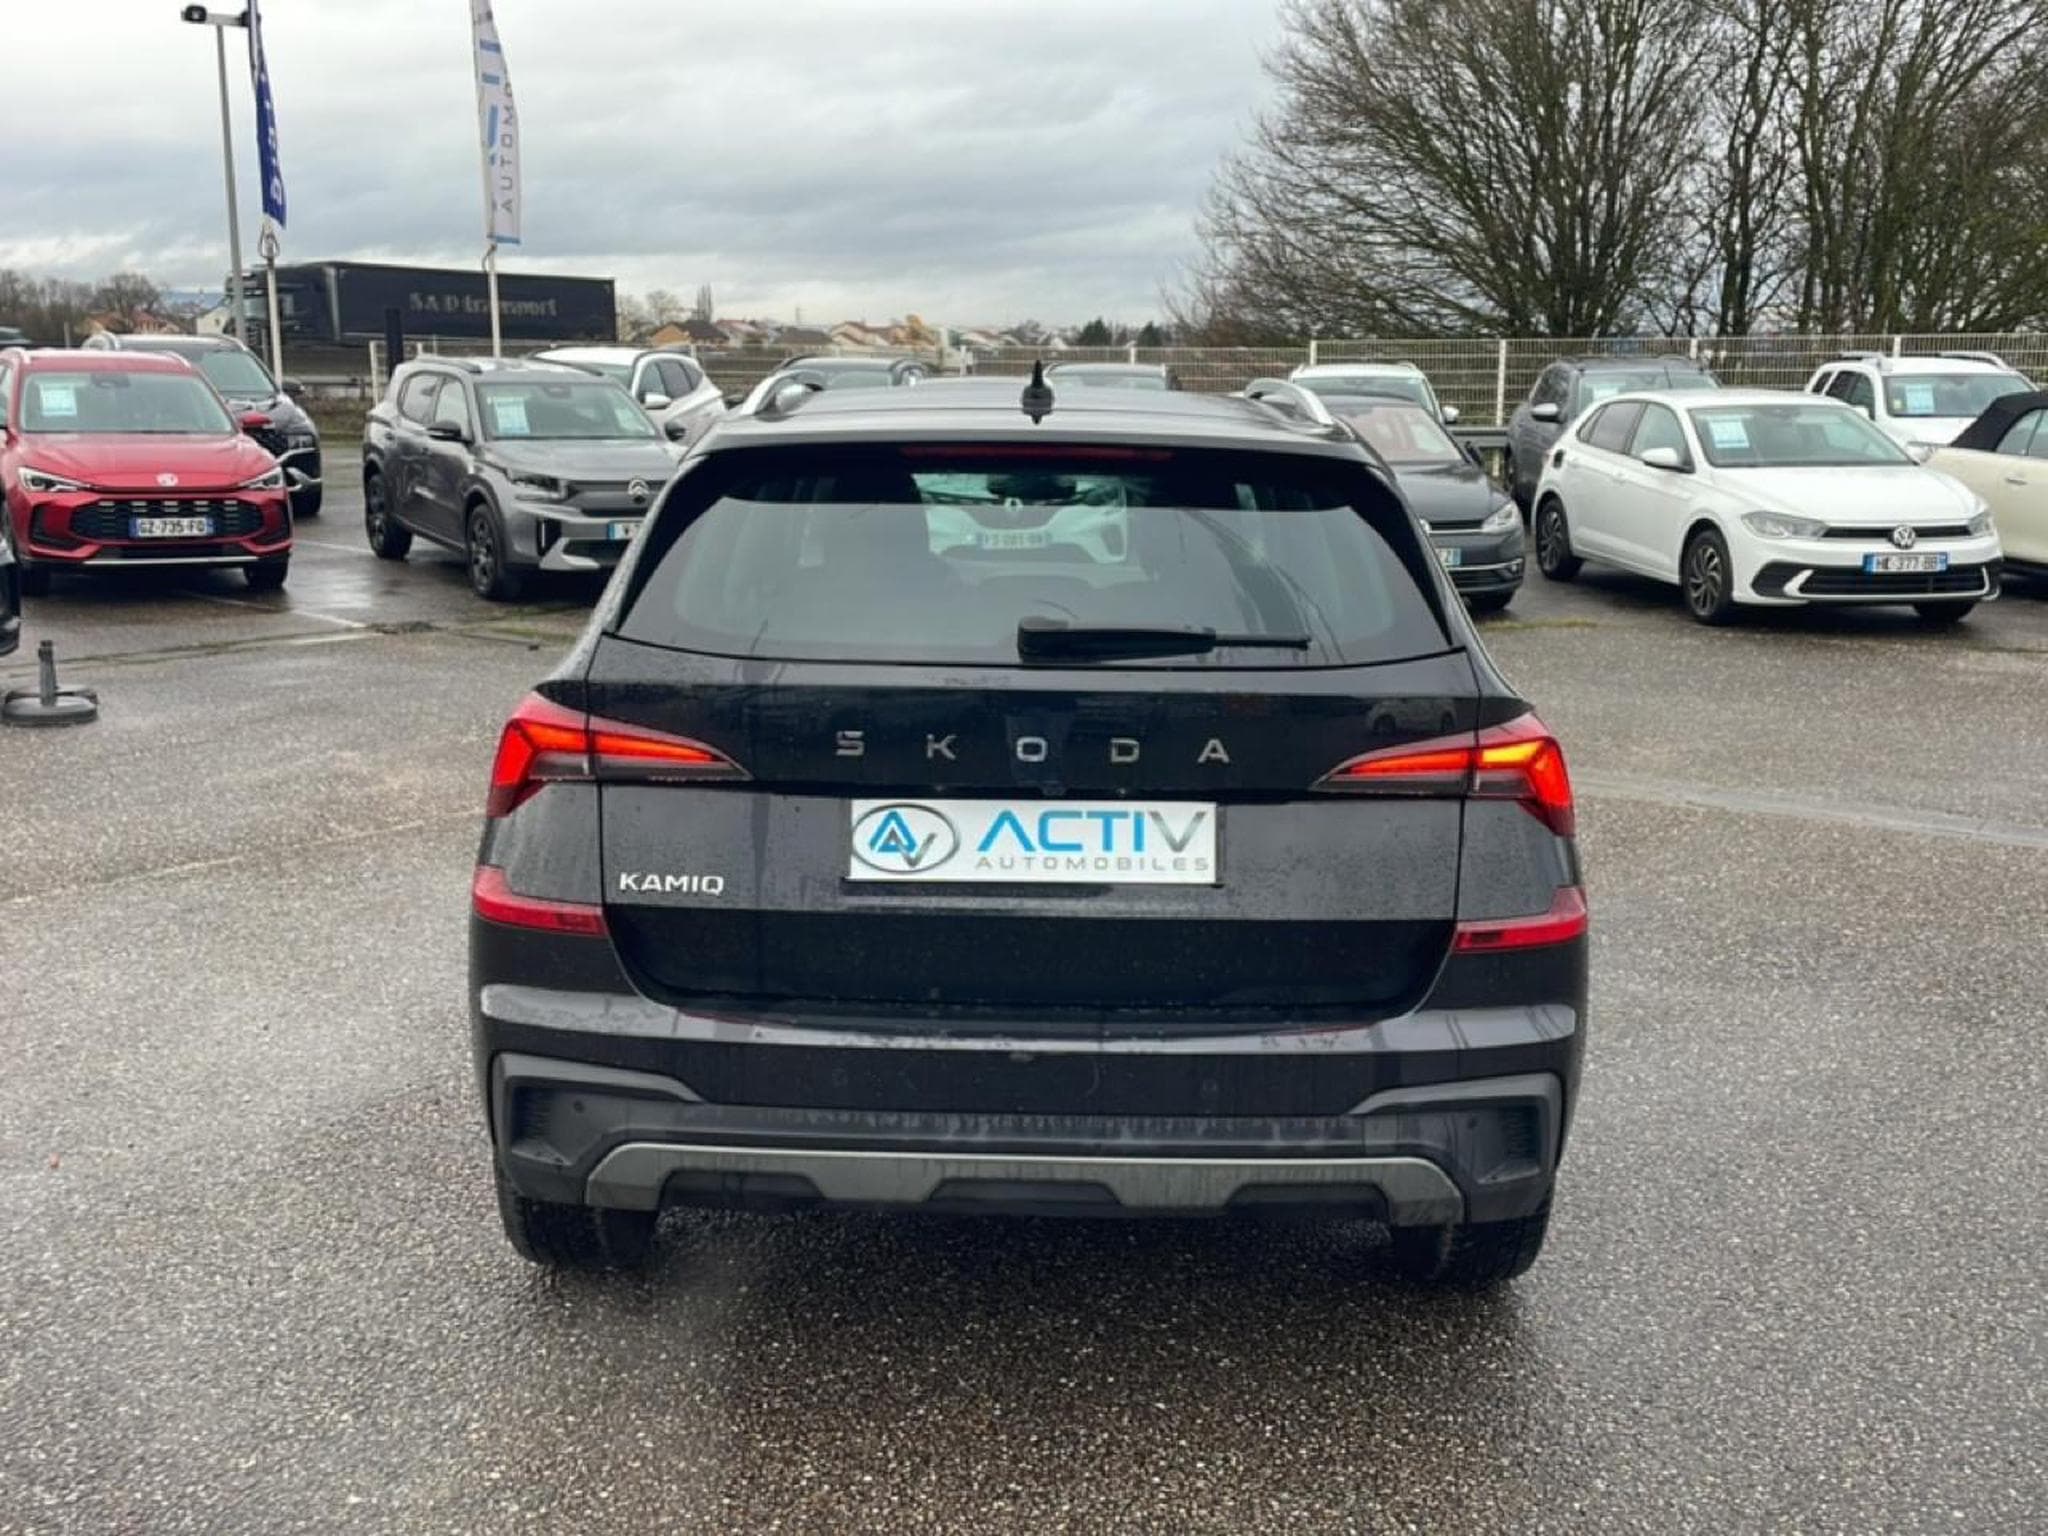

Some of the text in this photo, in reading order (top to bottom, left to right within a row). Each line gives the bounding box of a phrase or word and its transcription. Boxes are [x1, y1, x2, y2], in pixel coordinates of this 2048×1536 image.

[836, 730, 1230, 764] SKODA
[976, 809, 1207, 853] ACTIV
[976, 855, 1210, 872] AUTOMOBILES
[619, 872, 725, 896] KAMIQ
